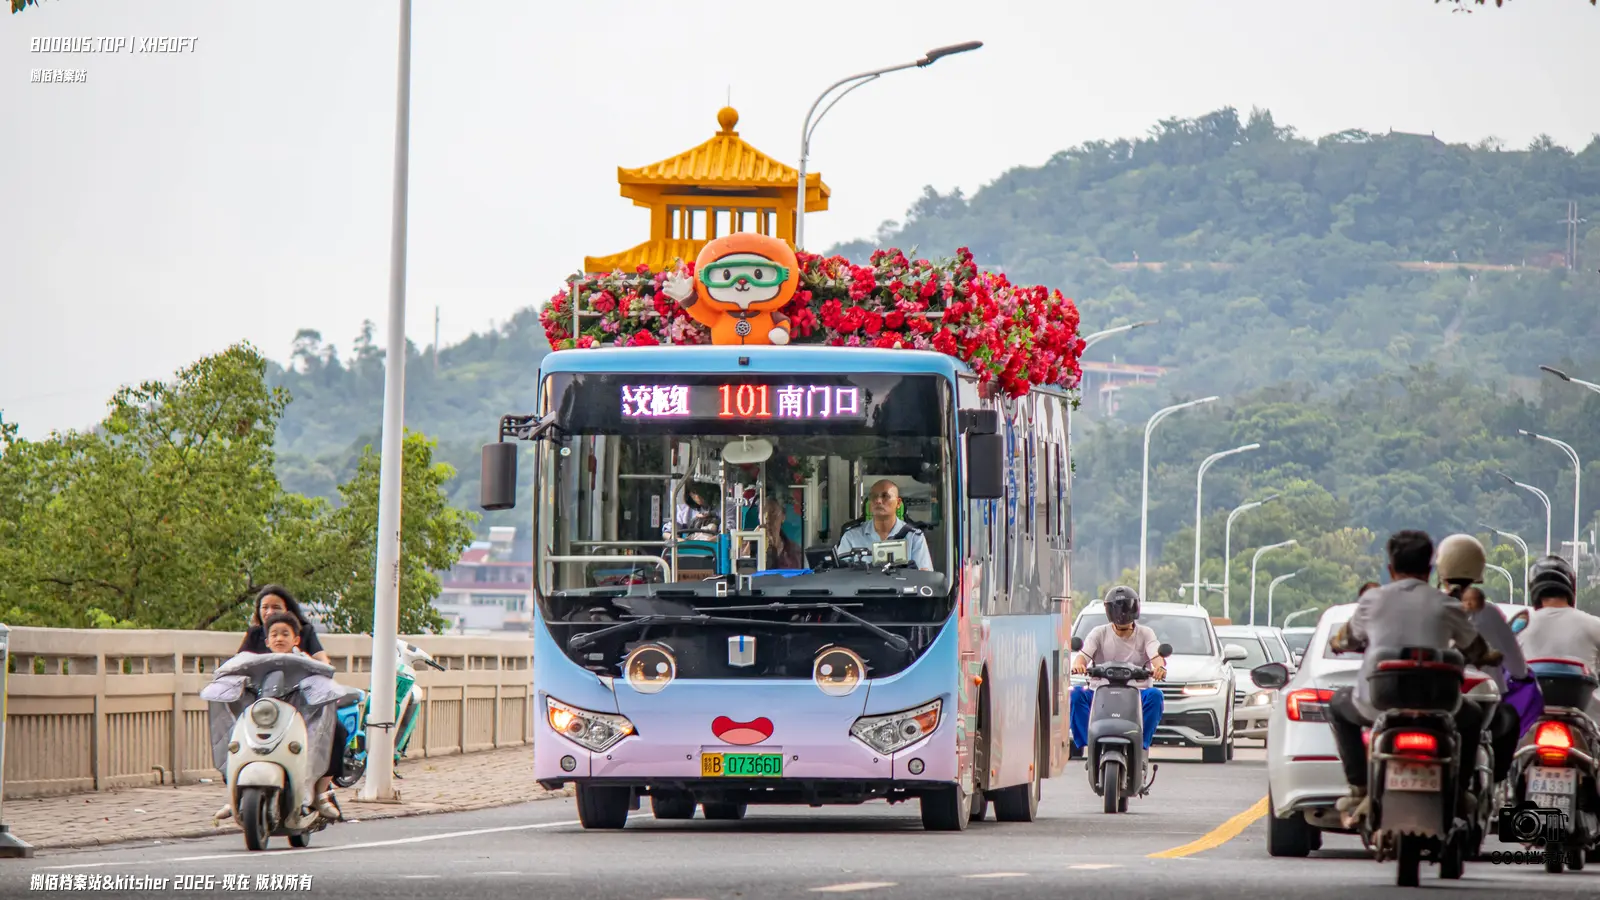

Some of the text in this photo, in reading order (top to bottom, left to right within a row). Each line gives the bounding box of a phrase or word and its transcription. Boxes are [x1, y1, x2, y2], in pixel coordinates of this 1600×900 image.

[718, 383, 772, 418] 101
[776, 384, 859, 418] 南门口
[728, 757, 781, 773] 07366D
